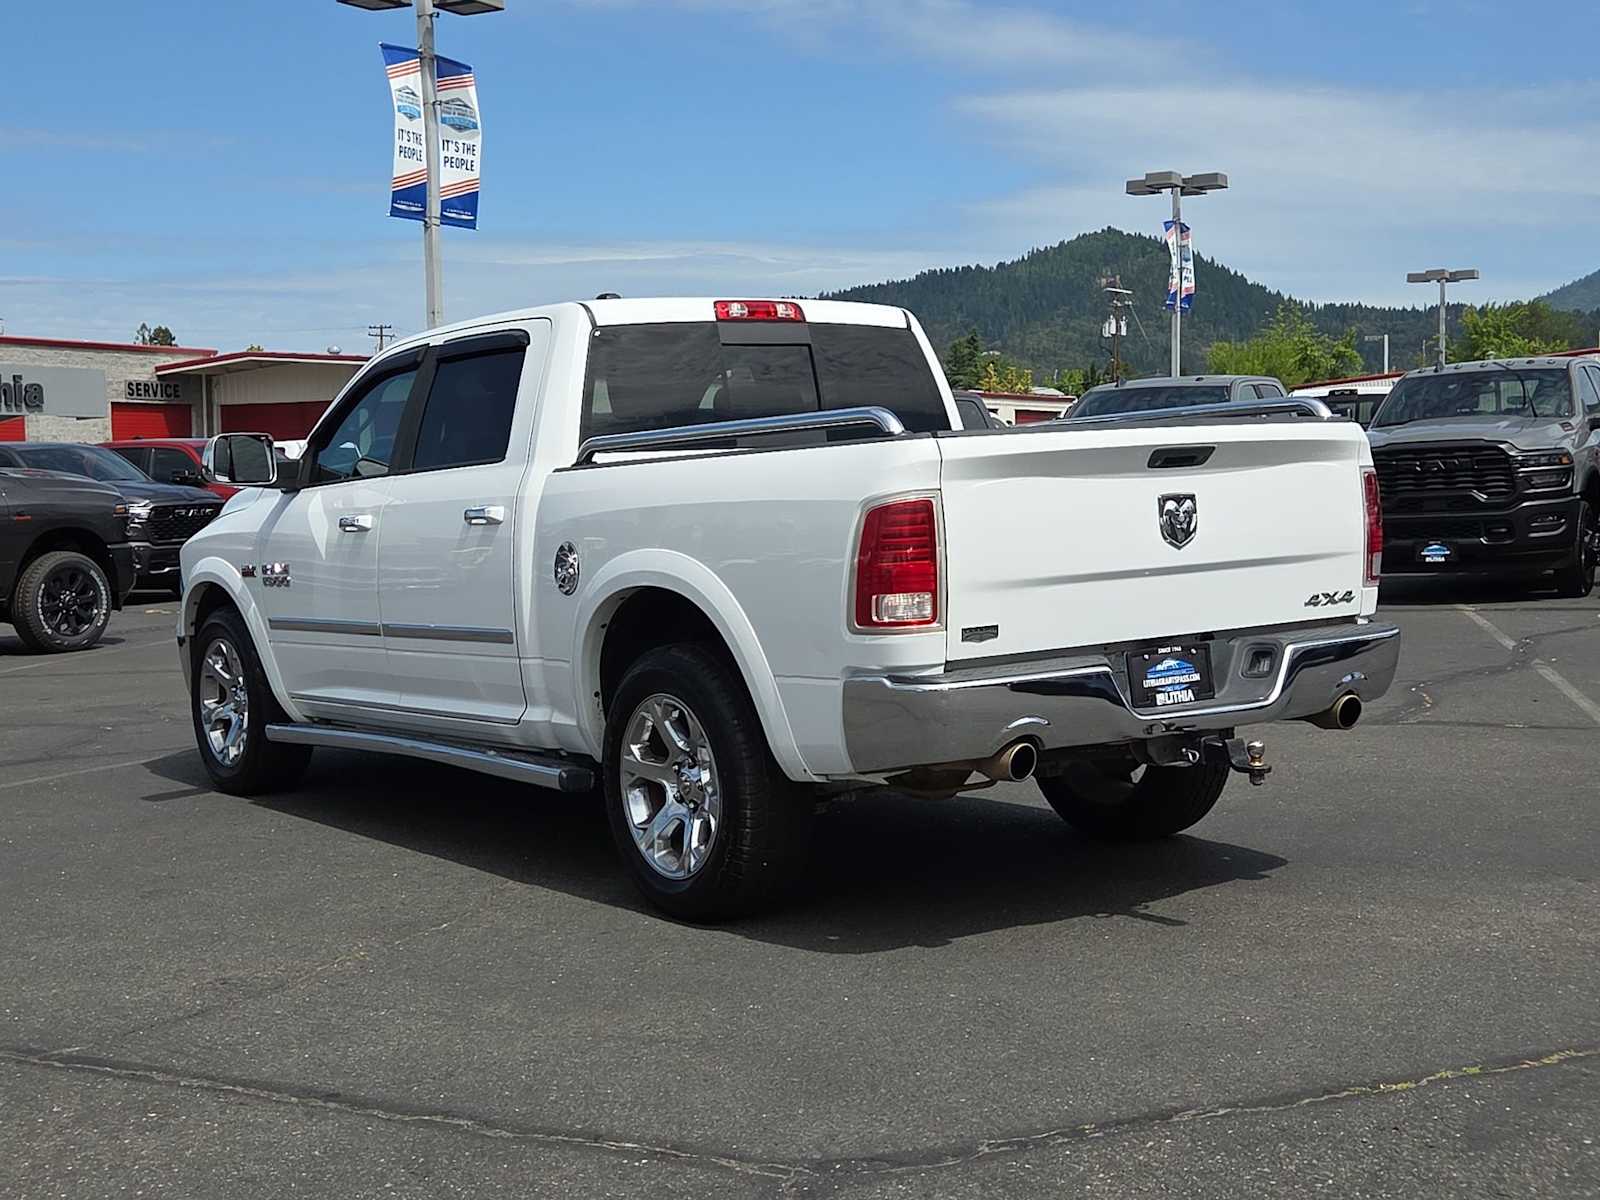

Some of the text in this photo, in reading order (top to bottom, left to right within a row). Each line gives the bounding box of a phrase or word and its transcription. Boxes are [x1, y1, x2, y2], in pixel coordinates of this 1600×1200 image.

[398, 128, 423, 146] IT'S THE
[398, 145, 423, 162] PEOPLE
[442, 139, 477, 156] IT'S THE
[443, 155, 475, 172] PEOPLE
[127, 381, 181, 398] SERVICE
